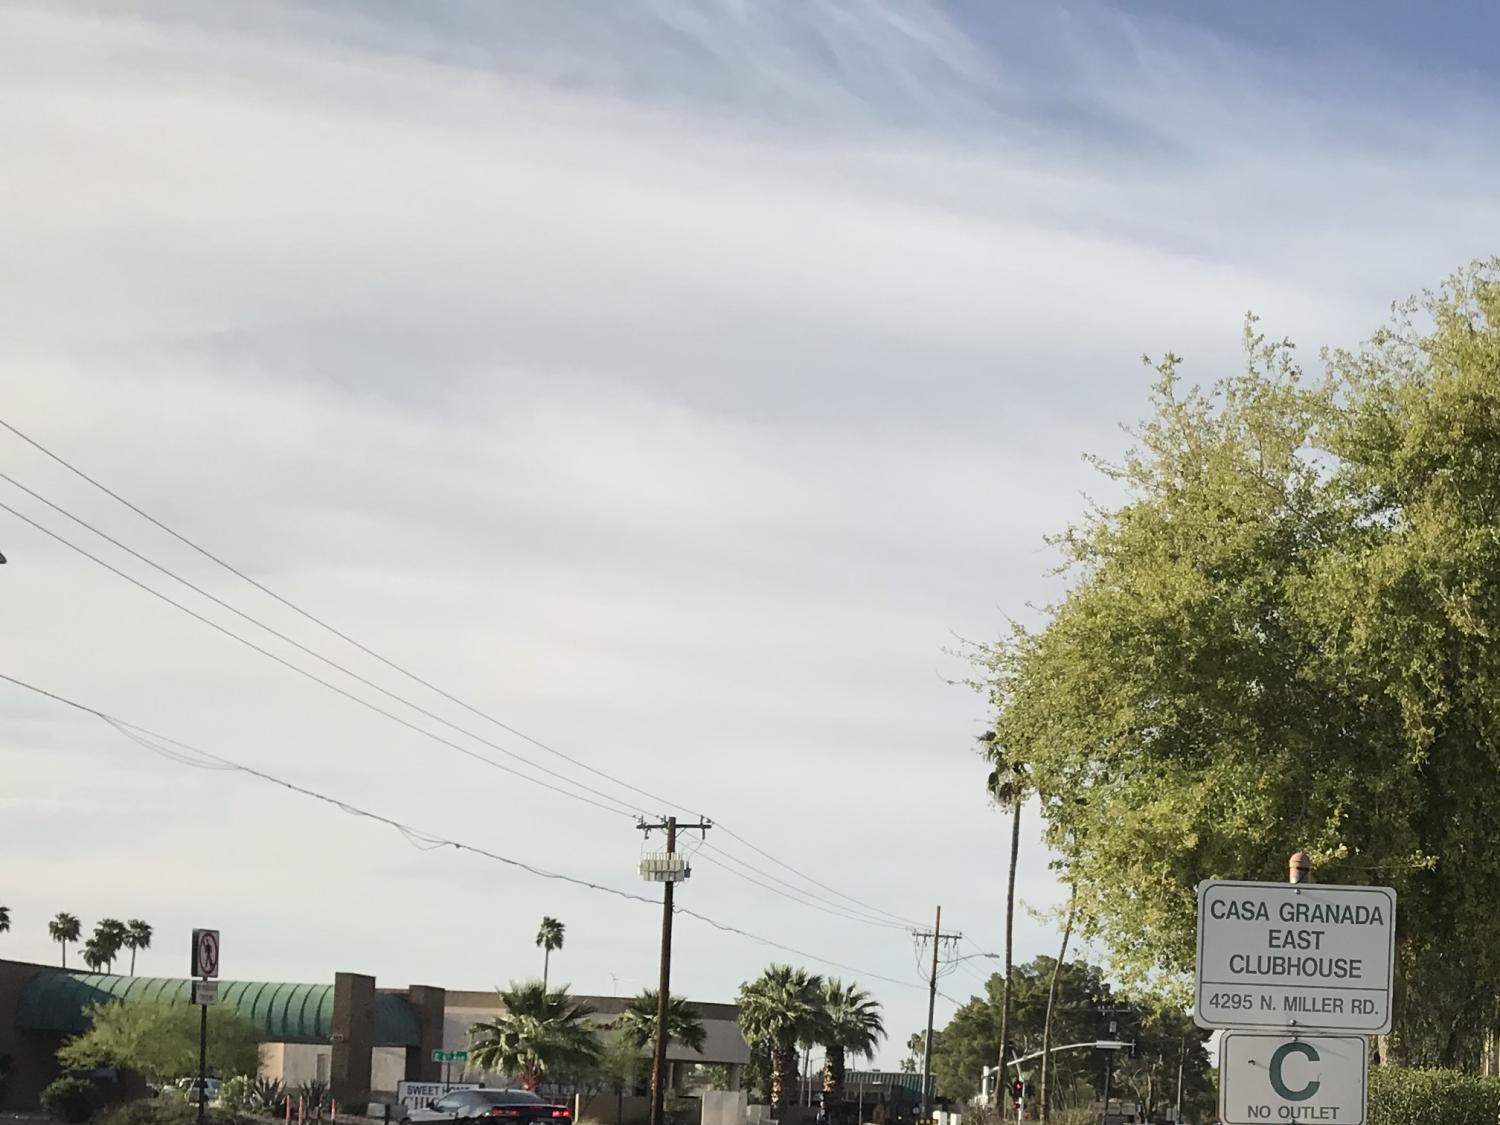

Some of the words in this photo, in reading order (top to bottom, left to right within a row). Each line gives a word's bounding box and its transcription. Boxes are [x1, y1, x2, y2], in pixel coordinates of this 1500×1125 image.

[1210, 899, 1270, 922] CASA
[1279, 902, 1384, 926] GRANADA
[1268, 929, 1325, 950] EAST
[1229, 954, 1363, 979] CLUBHOUSE
[1209, 993, 1253, 1010] 4295
[1260, 995, 1276, 1011] N.
[1283, 995, 1344, 1014] MILLER
[1351, 999, 1379, 1016] RD.
[1269, 1040, 1321, 1102] C
[407, 1085, 440, 1096] SWEET
[1247, 1105, 1271, 1119] NO
[1278, 1105, 1341, 1120] OUTLET
